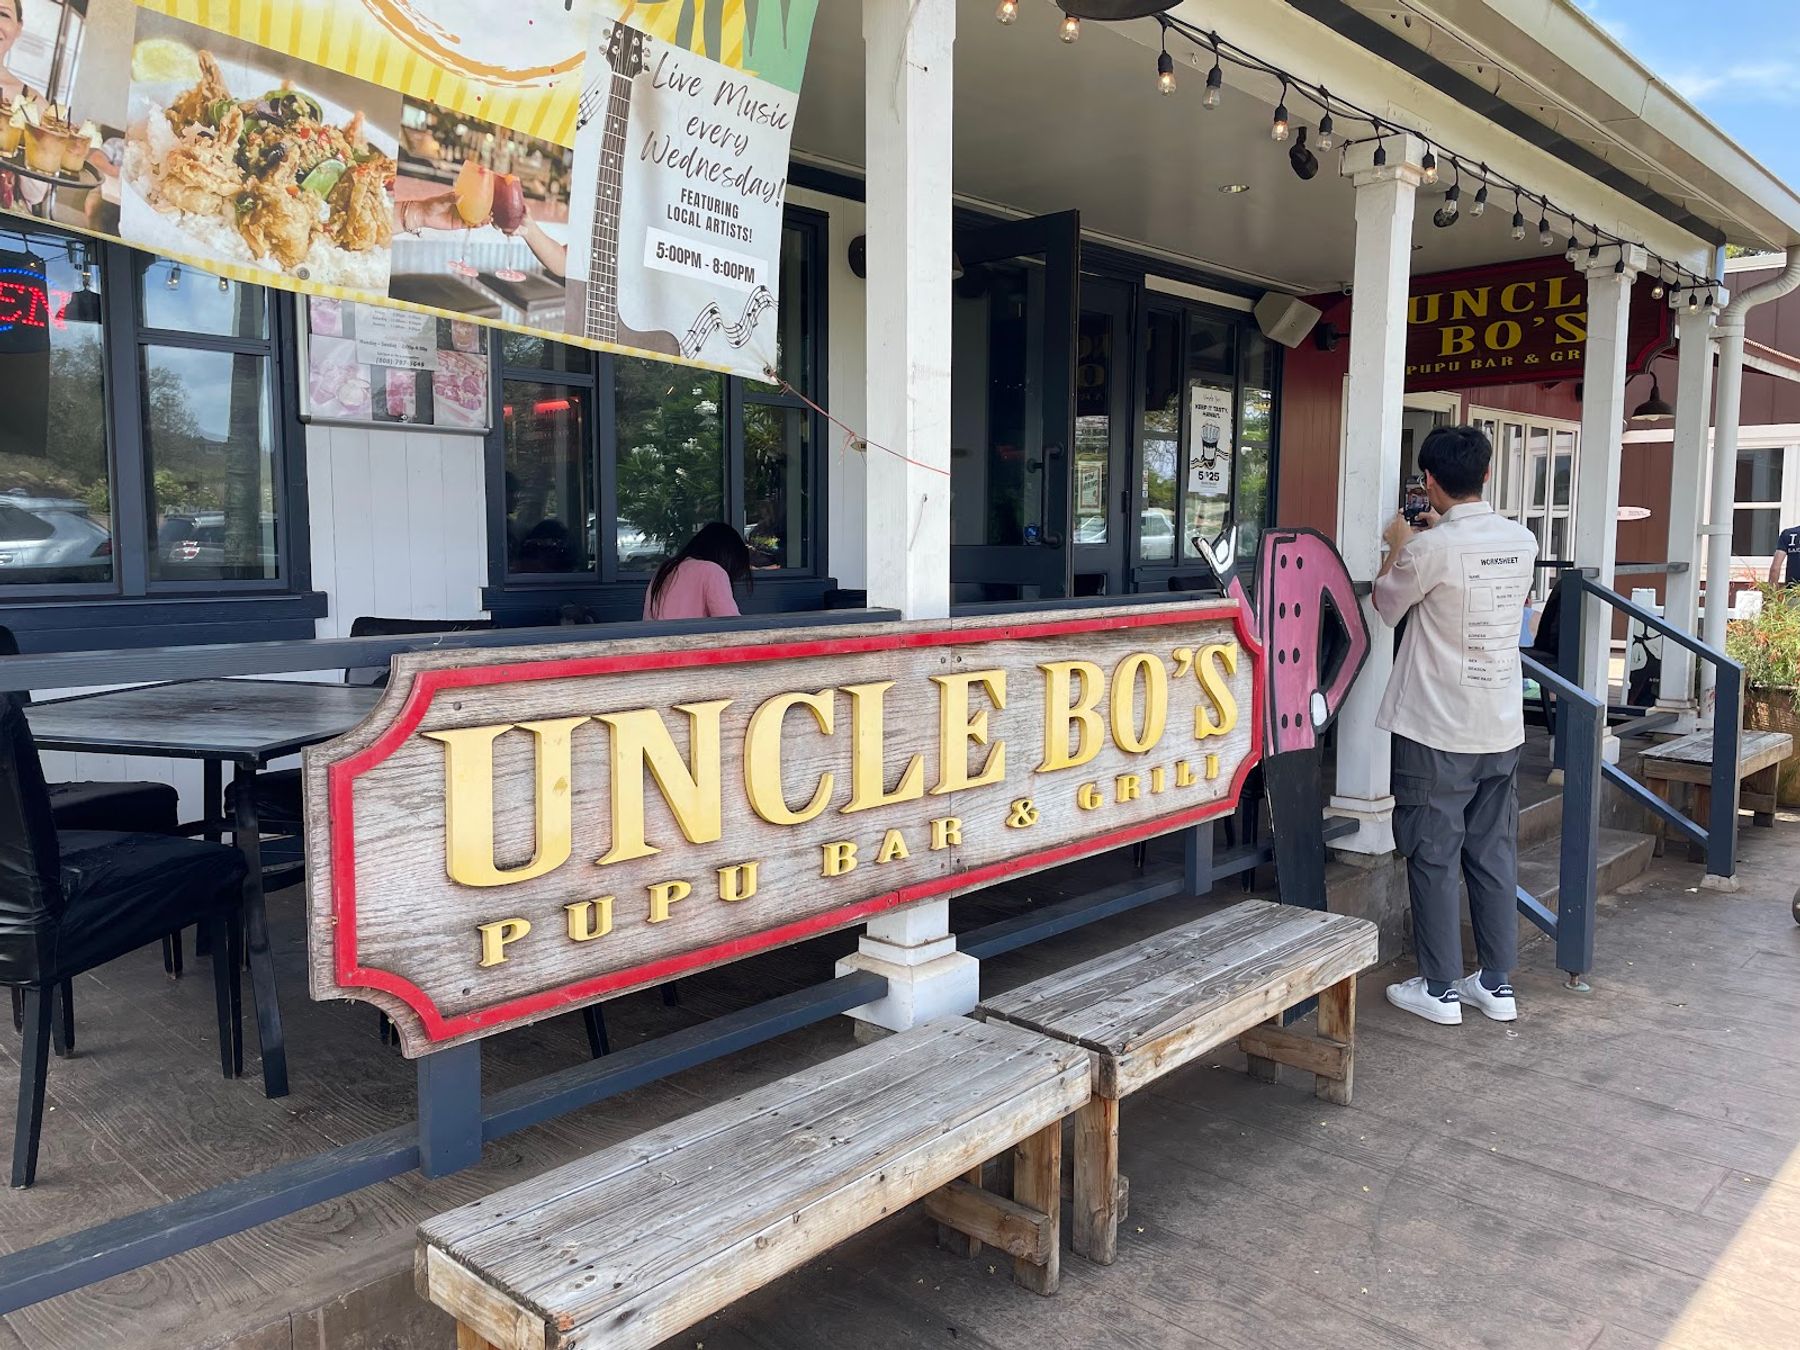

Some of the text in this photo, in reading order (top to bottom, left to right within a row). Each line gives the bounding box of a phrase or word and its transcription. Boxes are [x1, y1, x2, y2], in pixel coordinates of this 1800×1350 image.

[652, 51, 792, 130] Live Music
[686, 116, 749, 157] every
[640, 131, 786, 207] Wednesday!
[667, 204, 753, 244] LOCAL ARTISTS!
[681, 188, 739, 219] FEATURING
[656, 241, 702, 269] 5:00PM
[713, 258, 756, 284] 8:00PM
[0, 281, 72, 331] EN
[1408, 276, 1582, 325] UNCL
[1407, 350, 1582, 376] PUPU BAR & GR
[1198, 471, 1204, 480] 5
[1789, 533, 1798, 546] I
[1480, 556, 1518, 566] WORKSHEET
[419, 669, 1007, 888] UNCLE
[476, 860, 761, 968] PUPU
[821, 816, 963, 877] BAR
[1006, 798, 1041, 829] &
